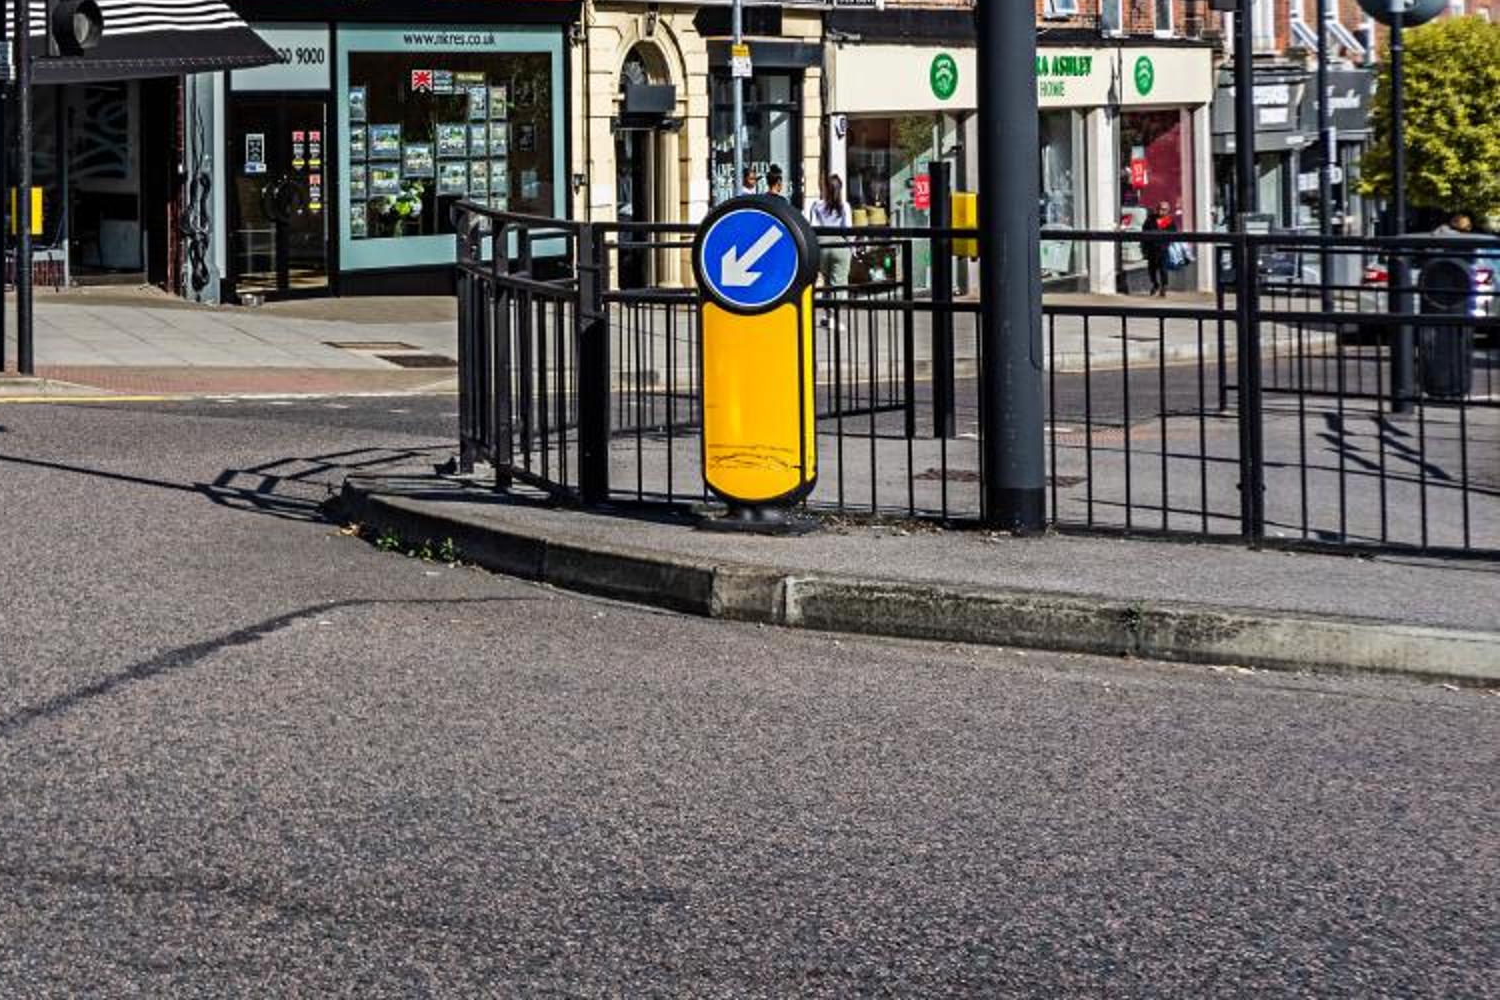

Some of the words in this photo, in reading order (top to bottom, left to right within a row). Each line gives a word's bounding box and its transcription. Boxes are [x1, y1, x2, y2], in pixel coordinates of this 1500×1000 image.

[295, 47, 325, 64] 9000
[1052, 55, 1093, 76] ASHLEY
[1040, 81, 1065, 97] HOME
